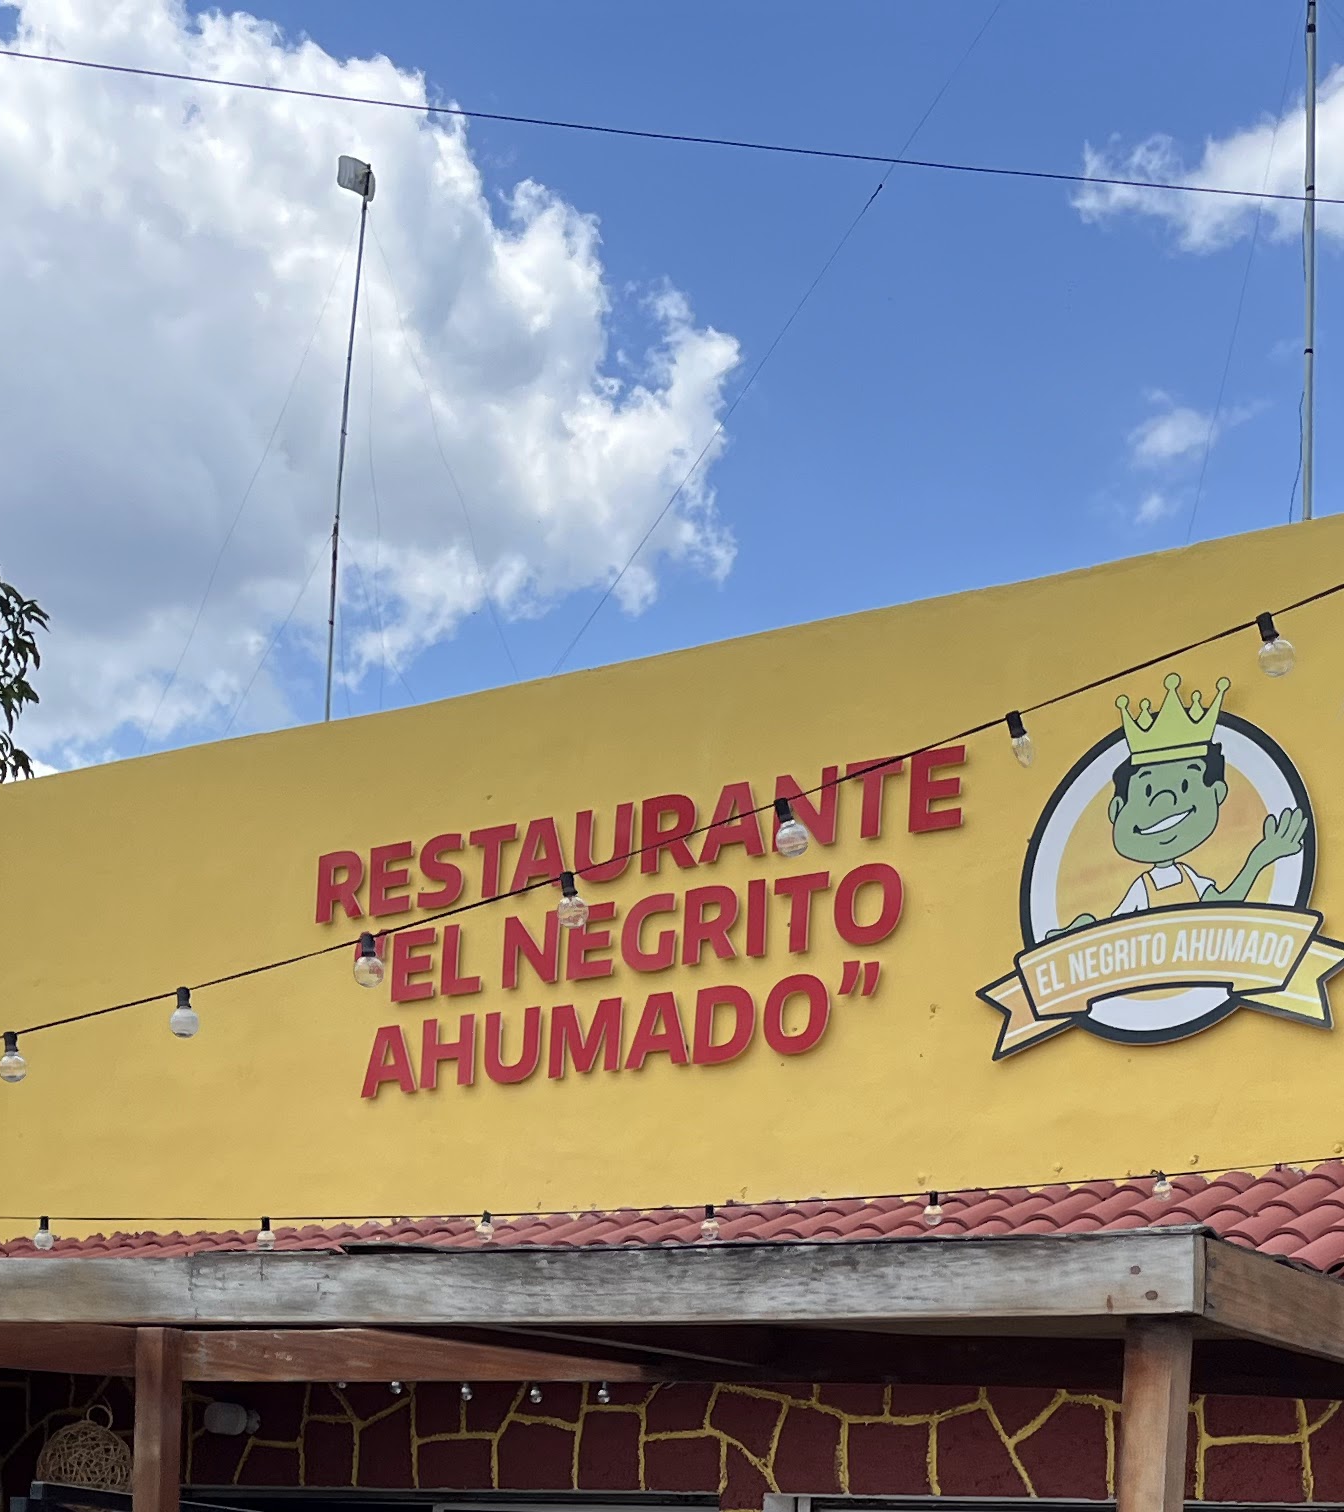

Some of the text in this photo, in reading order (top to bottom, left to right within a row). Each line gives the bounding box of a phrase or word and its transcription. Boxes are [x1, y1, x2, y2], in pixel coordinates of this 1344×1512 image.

[316, 745, 966, 923] RESTAURANTE
[502, 862, 904, 988] NEGRITO
[1035, 927, 1296, 997] EL NEGRITO AHUMADO
[361, 960, 881, 1098] AHUMADO”
